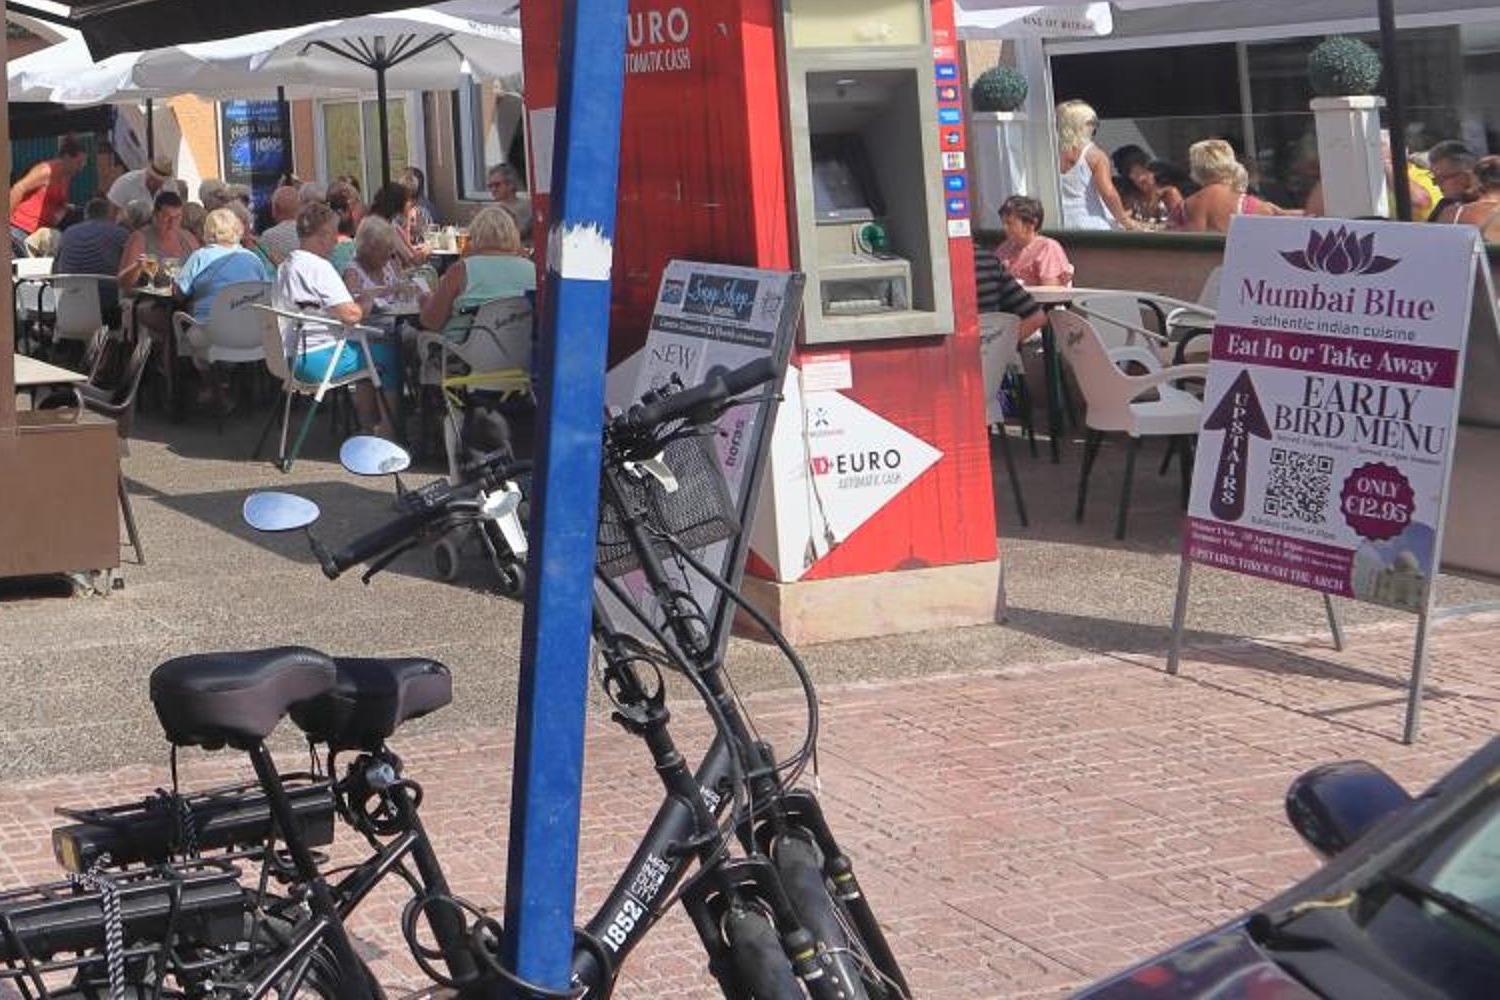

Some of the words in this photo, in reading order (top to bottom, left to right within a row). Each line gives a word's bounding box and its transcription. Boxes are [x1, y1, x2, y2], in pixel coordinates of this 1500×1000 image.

[627, 7, 689, 47] URO
[625, 53, 664, 73] TOMATIC
[1241, 278, 1355, 313] Mumbai
[1364, 287, 1435, 321] Blue
[1251, 314, 1315, 331] authentic
[1317, 320, 1359, 335] indian
[1363, 326, 1416, 341] cuisine
[1227, 333, 1258, 356] Eat
[1265, 336, 1283, 360] In
[1289, 344, 1314, 362] or
[1320, 343, 1372, 370] Take
[1377, 351, 1438, 382] Away
[1302, 376, 1422, 422] EARLY
[1220, 392, 1249, 505] UPSTAIRS
[1275, 404, 1345, 439] BIRD
[1353, 415, 1445, 455] MENU
[837, 449, 901, 474] EURO
[1357, 478, 1400, 499] ONLY
[602, 899, 643, 952] 1852
